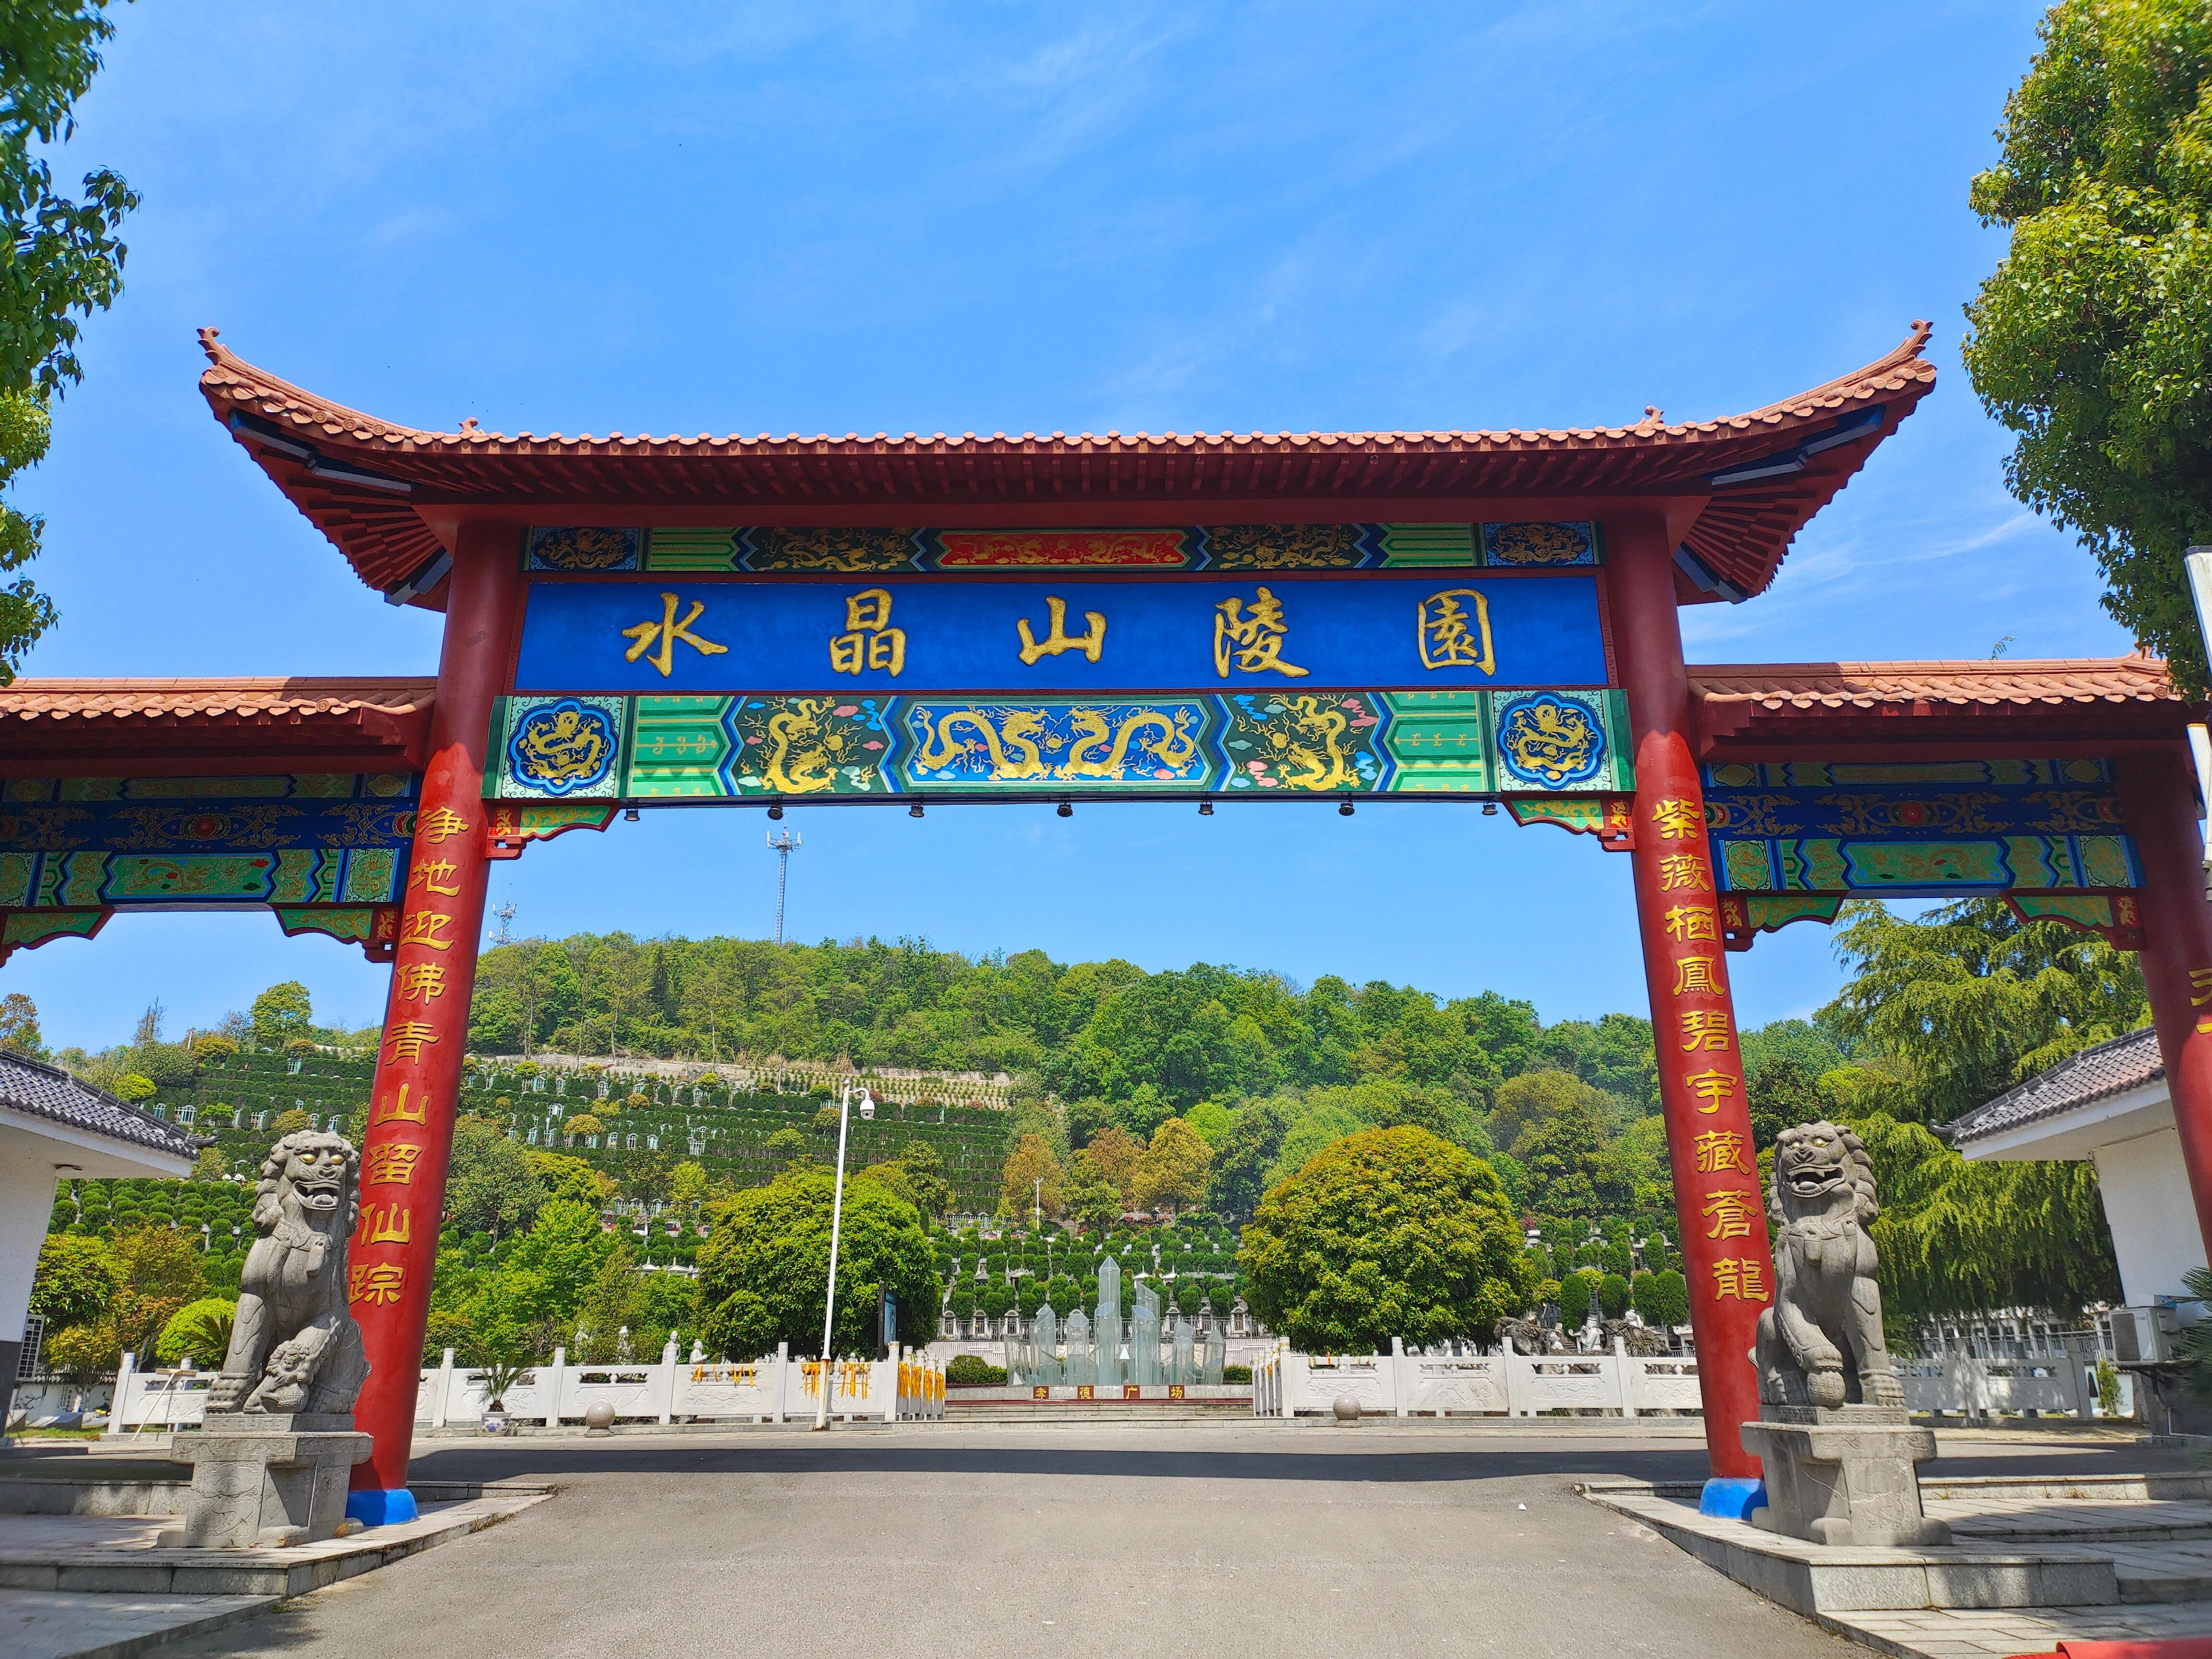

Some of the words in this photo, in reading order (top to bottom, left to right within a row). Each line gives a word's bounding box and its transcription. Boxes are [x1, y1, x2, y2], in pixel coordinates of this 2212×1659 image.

[622, 587, 1496, 678] 水晶山陵園
[1035, 1386, 1183, 1399] 孝德广场
